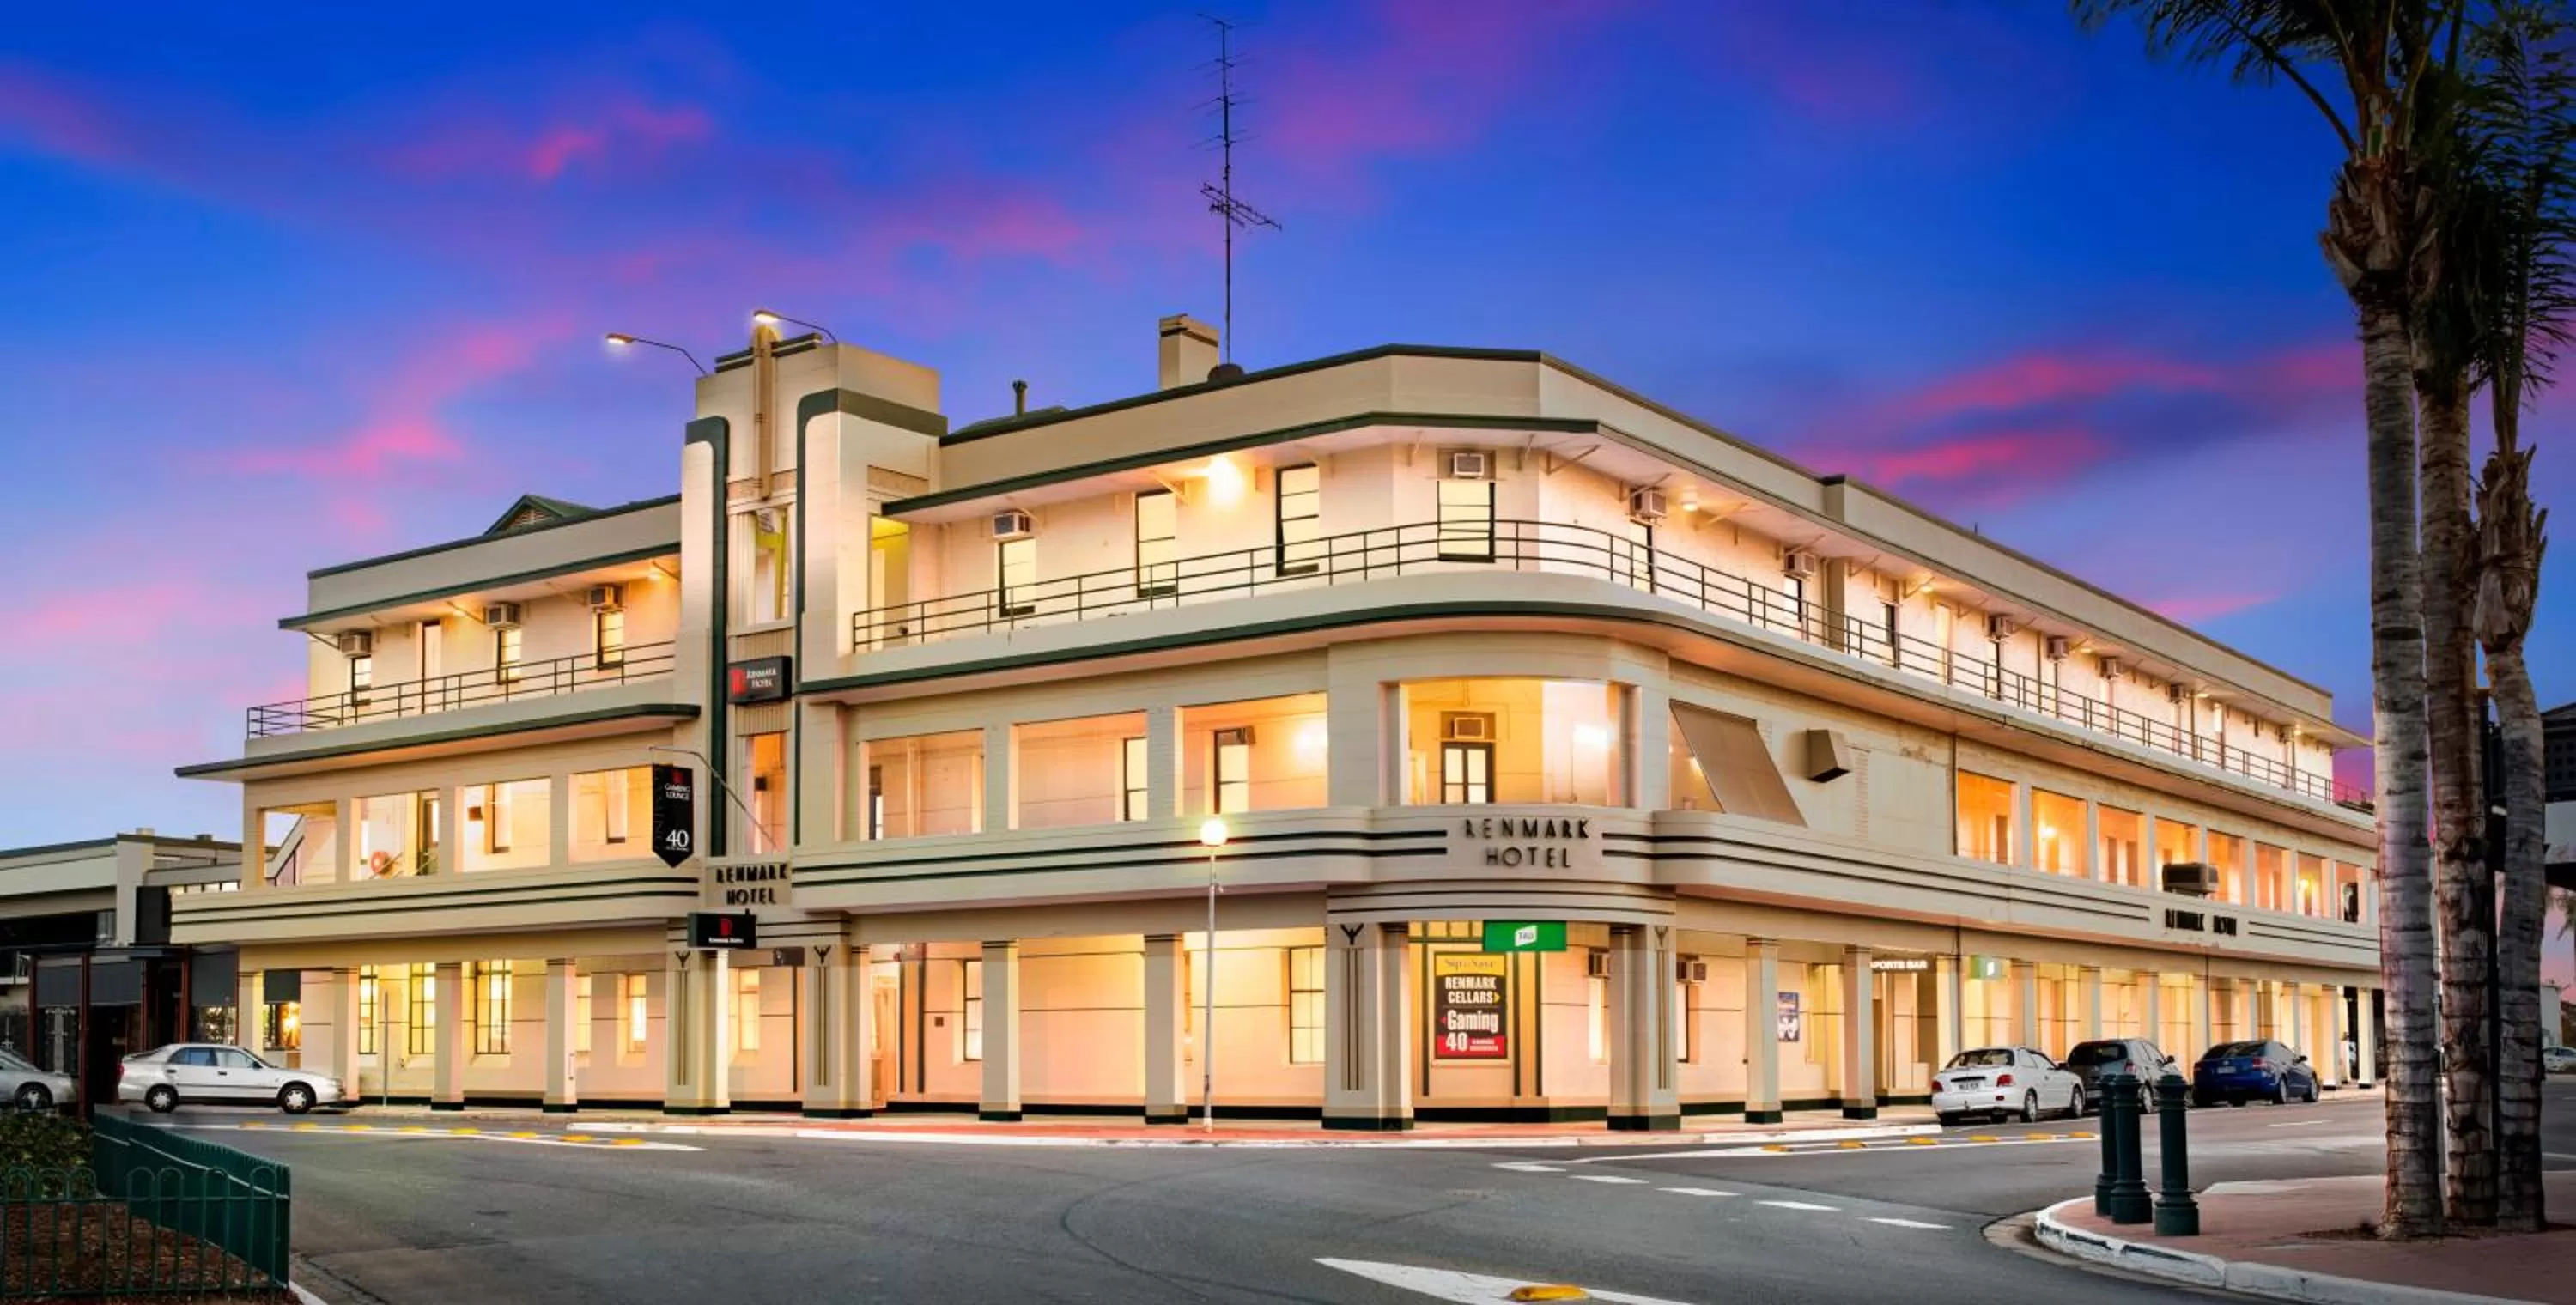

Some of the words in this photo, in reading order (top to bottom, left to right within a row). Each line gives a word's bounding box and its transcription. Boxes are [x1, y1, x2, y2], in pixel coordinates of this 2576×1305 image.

[665, 783, 690, 792] GAMING
[665, 791, 690, 800] LOUNGE
[1465, 818, 1589, 839] RENMARK
[666, 829, 690, 847] 40
[1485, 846, 1571, 868] HOTEL
[716, 863, 787, 883] RENMARK
[726, 886, 777, 906] HOTEL
[1906, 960, 1928, 969] BAR
[1445, 976, 1497, 989] RENMARK
[1448, 991, 1493, 1004] CELLARS
[1447, 1009, 1498, 1034] Gaming
[1445, 1032, 1467, 1051] 40
